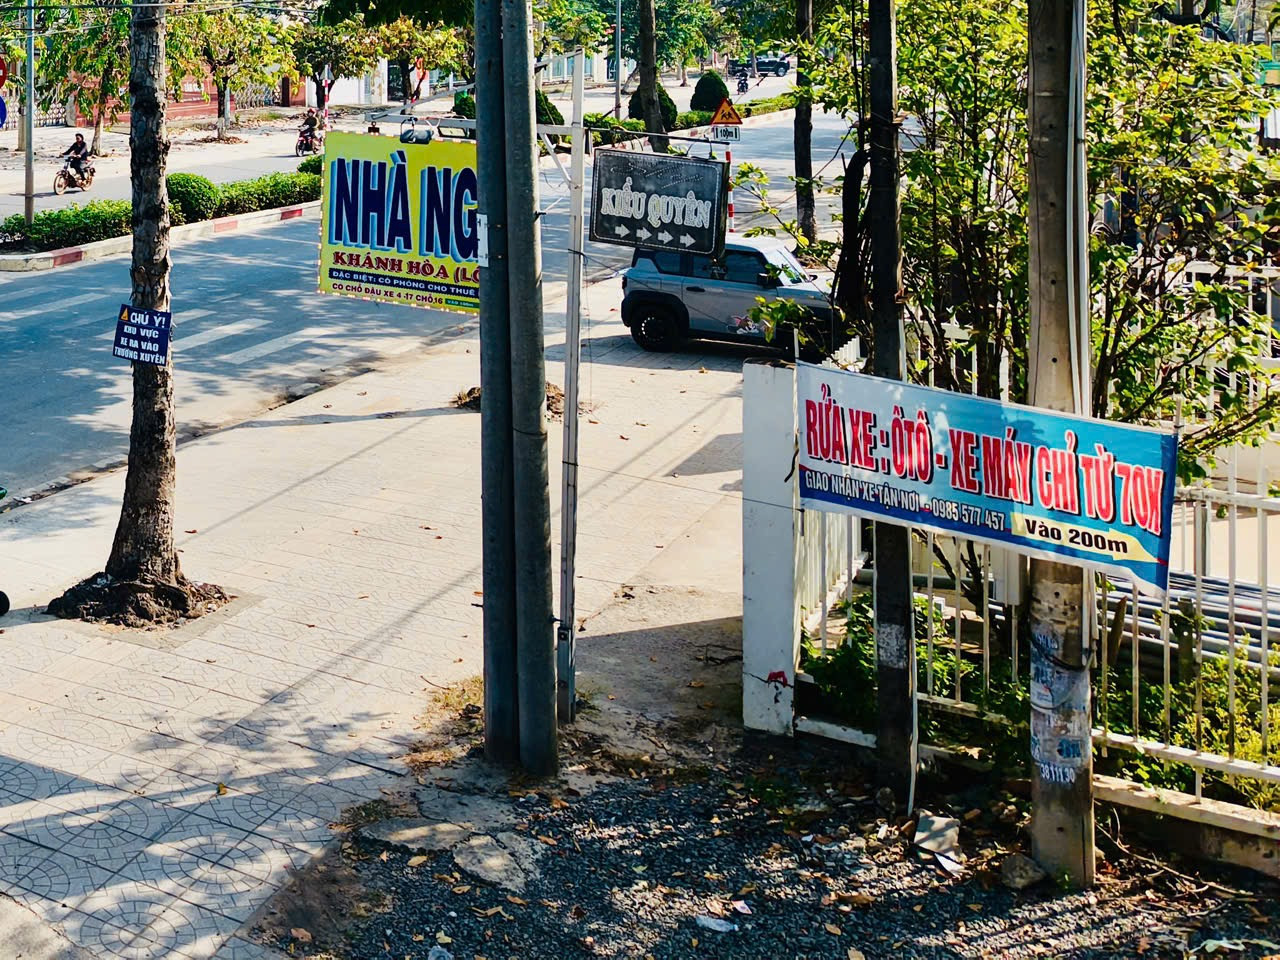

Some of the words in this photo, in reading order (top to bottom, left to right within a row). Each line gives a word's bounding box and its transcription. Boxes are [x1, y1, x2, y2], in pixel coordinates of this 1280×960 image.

[329, 150, 413, 253] NHÀ
[648, 190, 712, 228] QUYÊN
[333, 251, 403, 273] KHÁNH
[406, 259, 449, 279] HÒA
[383, 290, 394, 298] XE
[427, 283, 448, 292] CHO
[130, 311, 149, 325] CHÚ
[123, 325, 137, 335] KHU
[120, 337, 128, 346] XE
[129, 339, 139, 348] RA
[140, 352, 166, 365] XUYÊN
[805, 383, 848, 464] RỬA
[891, 404, 934, 483] ÔTÔ
[948, 428, 981, 495] XE
[981, 426, 1034, 506] MÁY
[1036, 429, 1081, 516] CHỈ
[1079, 443, 1116, 523] TỪ
[805, 470, 829, 490] GIAO
[831, 473, 860, 502] NHẬN
[861, 483, 876, 502] XE
[876, 482, 899, 509] TẬN
[899, 490, 920, 513] NƠI
[932, 497, 960, 521] 0985
[961, 505, 982, 526] 577
[985, 510, 1005, 531] 457
[1024, 517, 1062, 540] Vào
[1068, 529, 1128, 554] 200m
